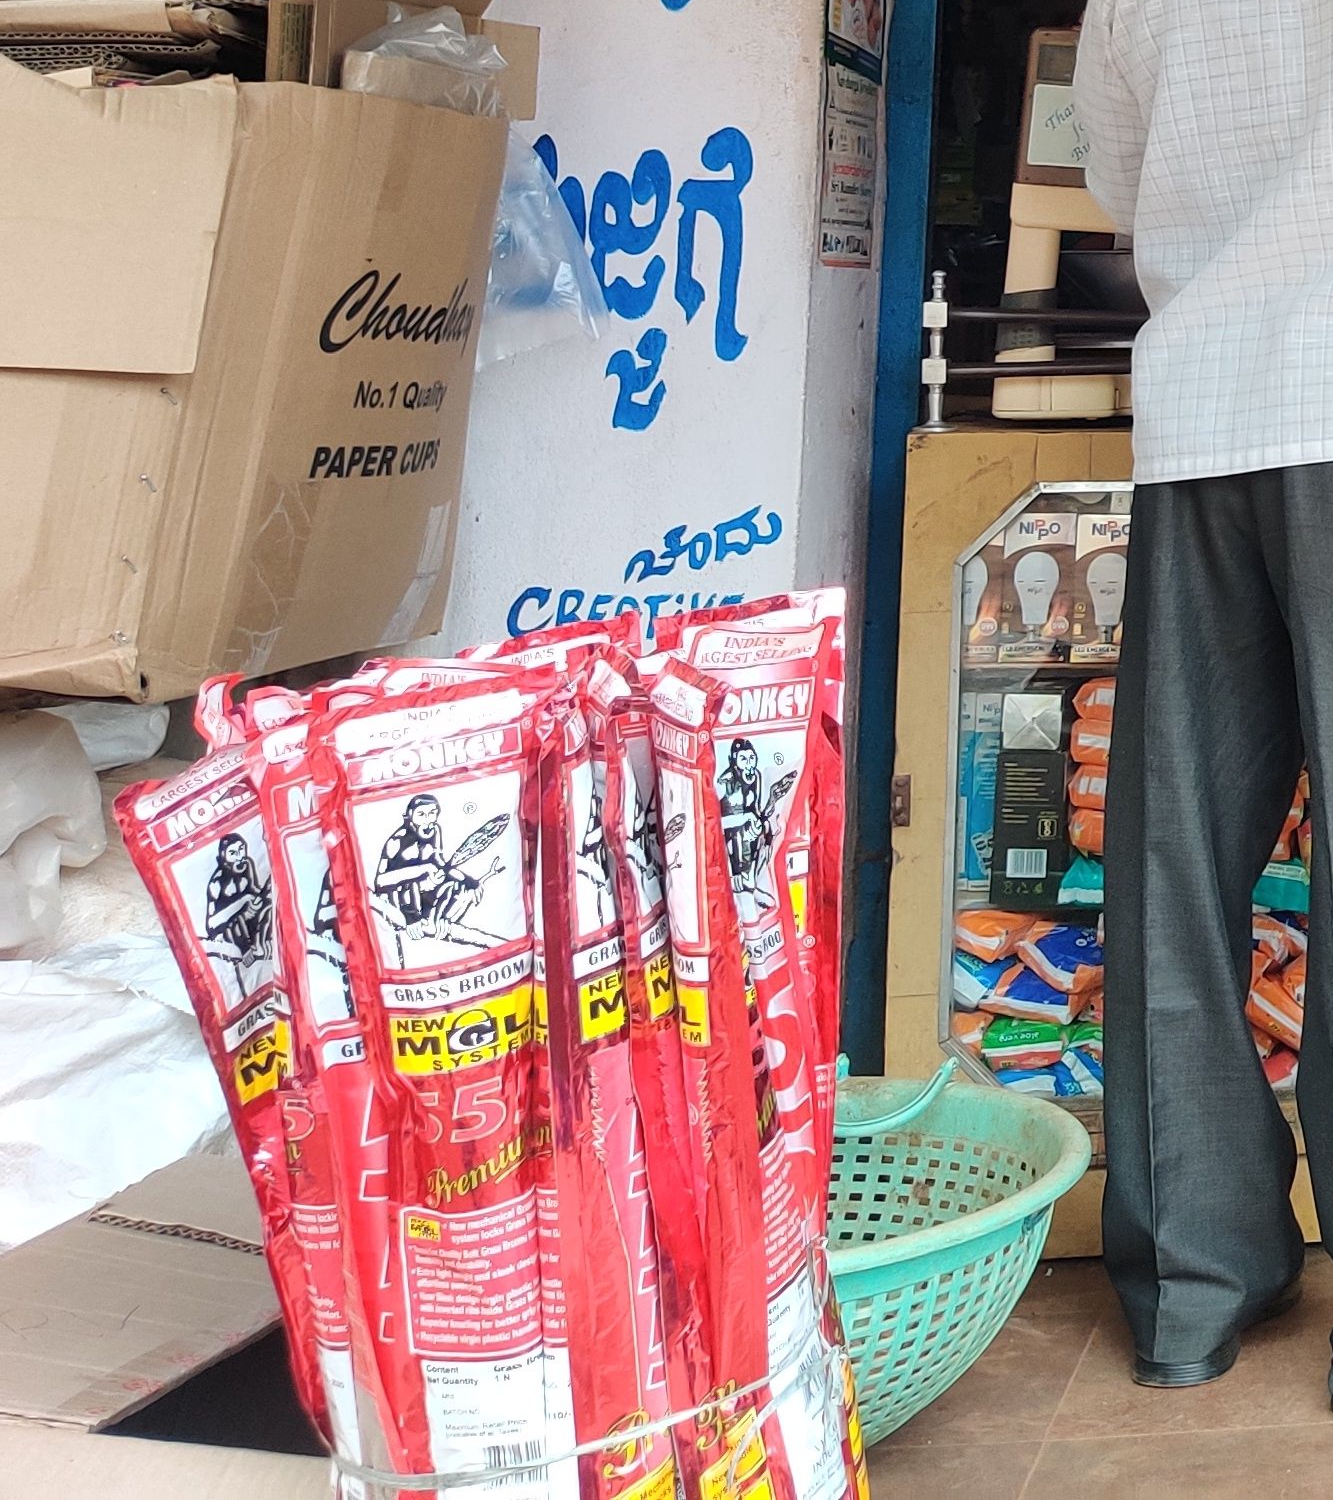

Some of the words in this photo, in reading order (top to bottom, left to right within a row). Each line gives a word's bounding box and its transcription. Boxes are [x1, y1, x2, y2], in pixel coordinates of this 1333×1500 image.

[352, 380, 399, 409] No.1
[402, 379, 448, 414] Quality
[308, 445, 399, 480] PAPER
[400, 437, 441, 476] CUPS
[1018, 518, 1062, 541] NIPPO
[724, 636, 787, 649] INDIA'S
[718, 683, 810, 726] ONKEY
[361, 729, 506, 784] MONKEY
[655, 722, 690, 759] ONKEY
[394, 983, 451, 1003] GRASS
[459, 957, 526, 994] BROOM
[237, 1003, 276, 1039] GRAS
[396, 1016, 446, 1033] NEW
[426, 1364, 459, 1374] Content
[441, 1377, 479, 1387] Quantity
